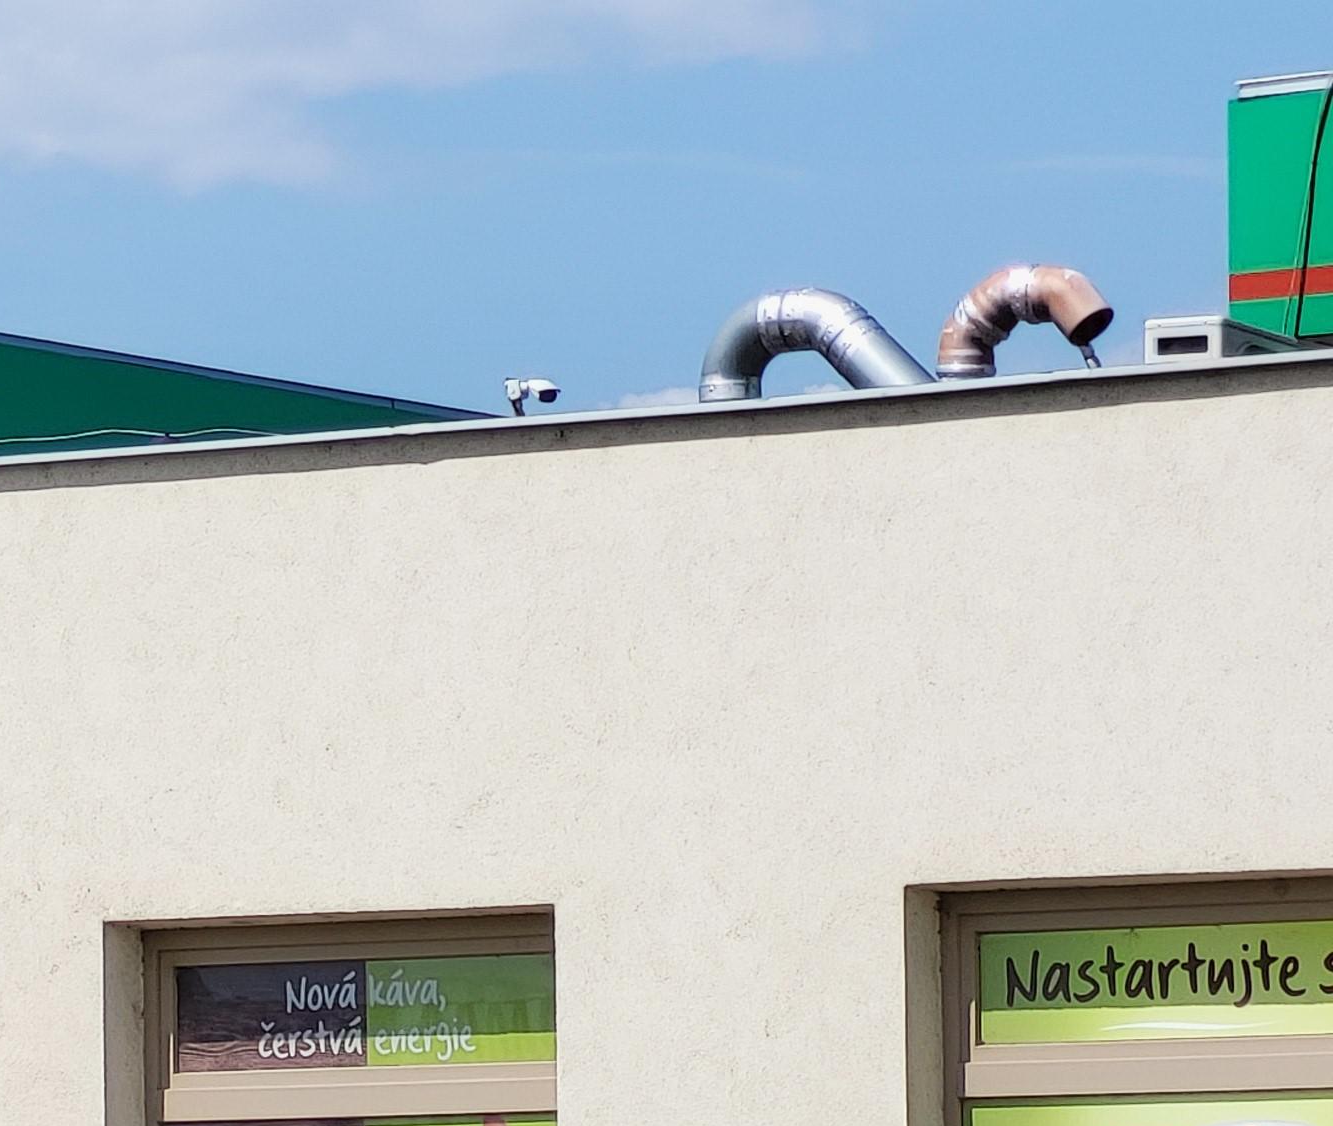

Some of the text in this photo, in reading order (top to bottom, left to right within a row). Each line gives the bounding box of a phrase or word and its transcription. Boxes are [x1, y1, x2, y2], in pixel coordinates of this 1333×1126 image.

[285, 969, 446, 1013] Nová káva,
[1005, 940, 1307, 1008] Nastartujte
[258, 1015, 476, 1061] čerstvá energie
